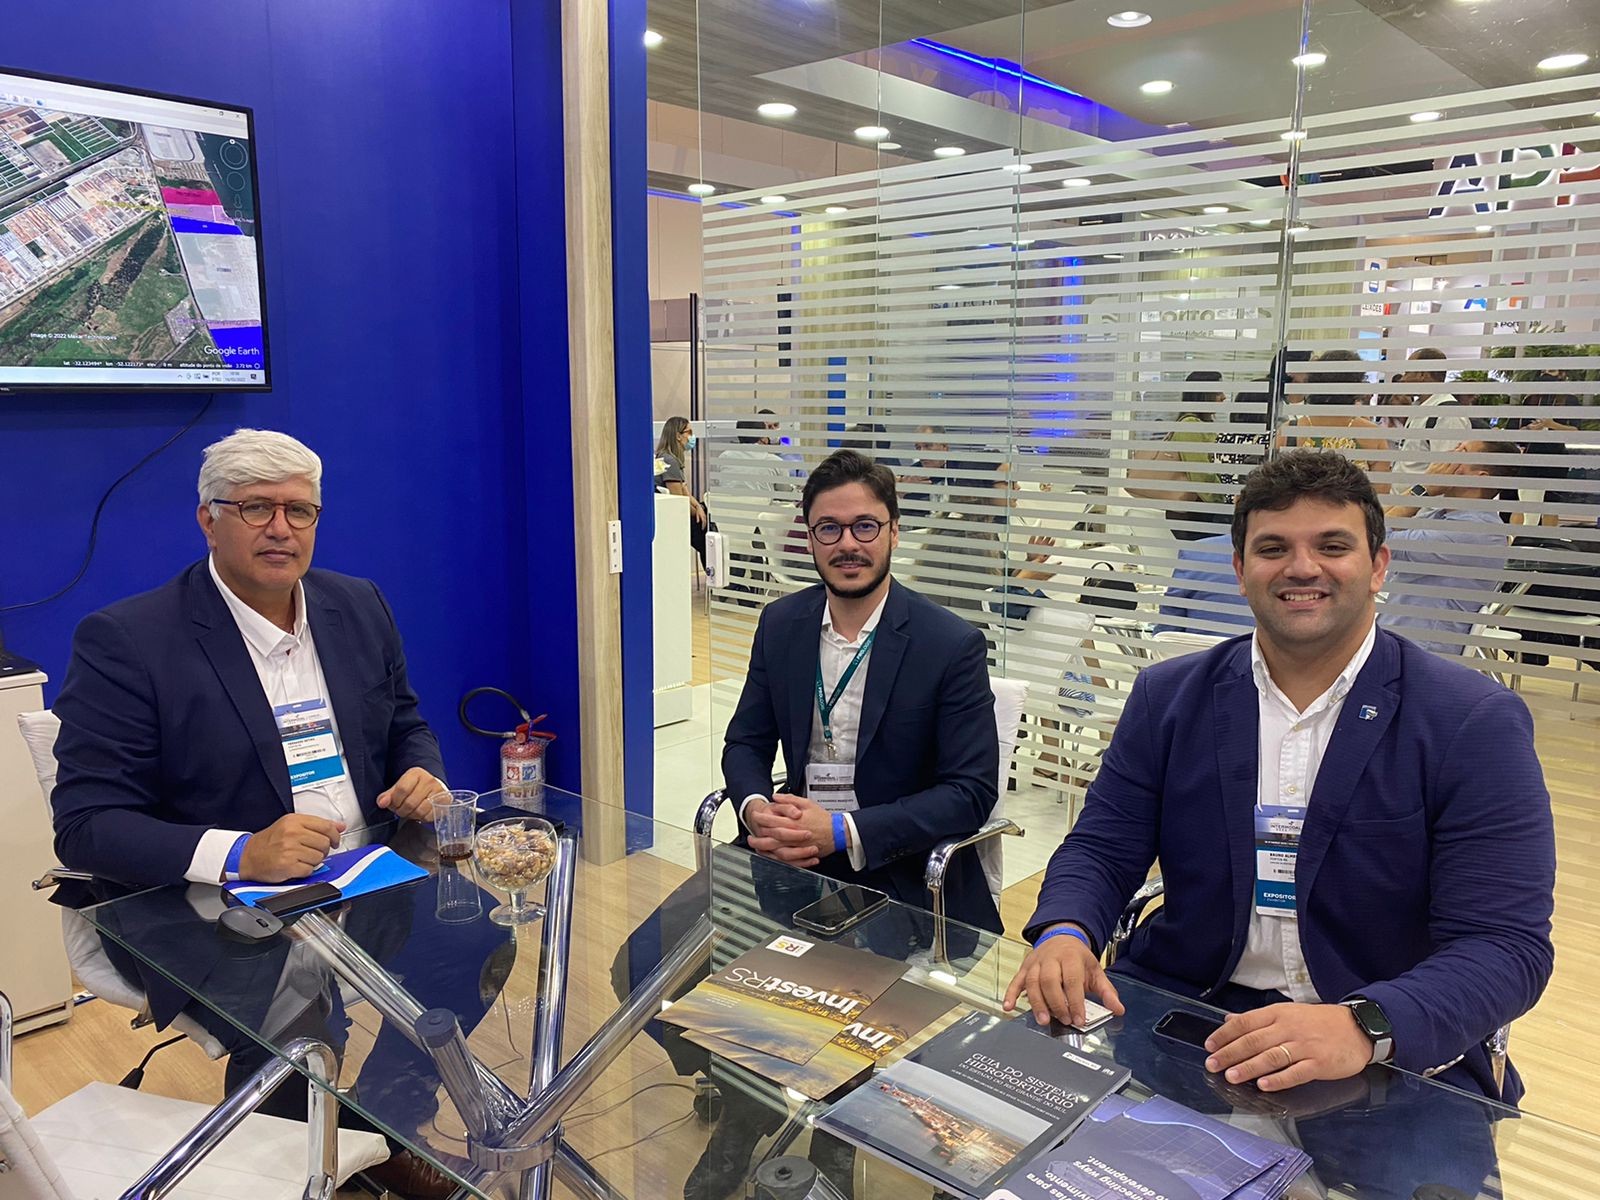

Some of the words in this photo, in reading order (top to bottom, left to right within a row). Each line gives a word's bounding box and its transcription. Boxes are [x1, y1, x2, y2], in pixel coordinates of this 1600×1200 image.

[203, 345, 236, 357] Google
[237, 346, 260, 356] Earth
[965, 1058, 1074, 1109] HIDROPORTUÁRIO
[972, 1052, 1000, 1069] GUIA
[1003, 1066, 1023, 1078] DO
[1025, 1076, 1079, 1103] SISTEMA
[1004, 1082, 1015, 1091] RIO
[1016, 1088, 1044, 1104] GRANDE
[1054, 1105, 1067, 1114] SUL
[1026, 1173, 1052, 1190] para
[1073, 1160, 1100, 1178] ways
[1087, 1156, 1156, 1196] development.
